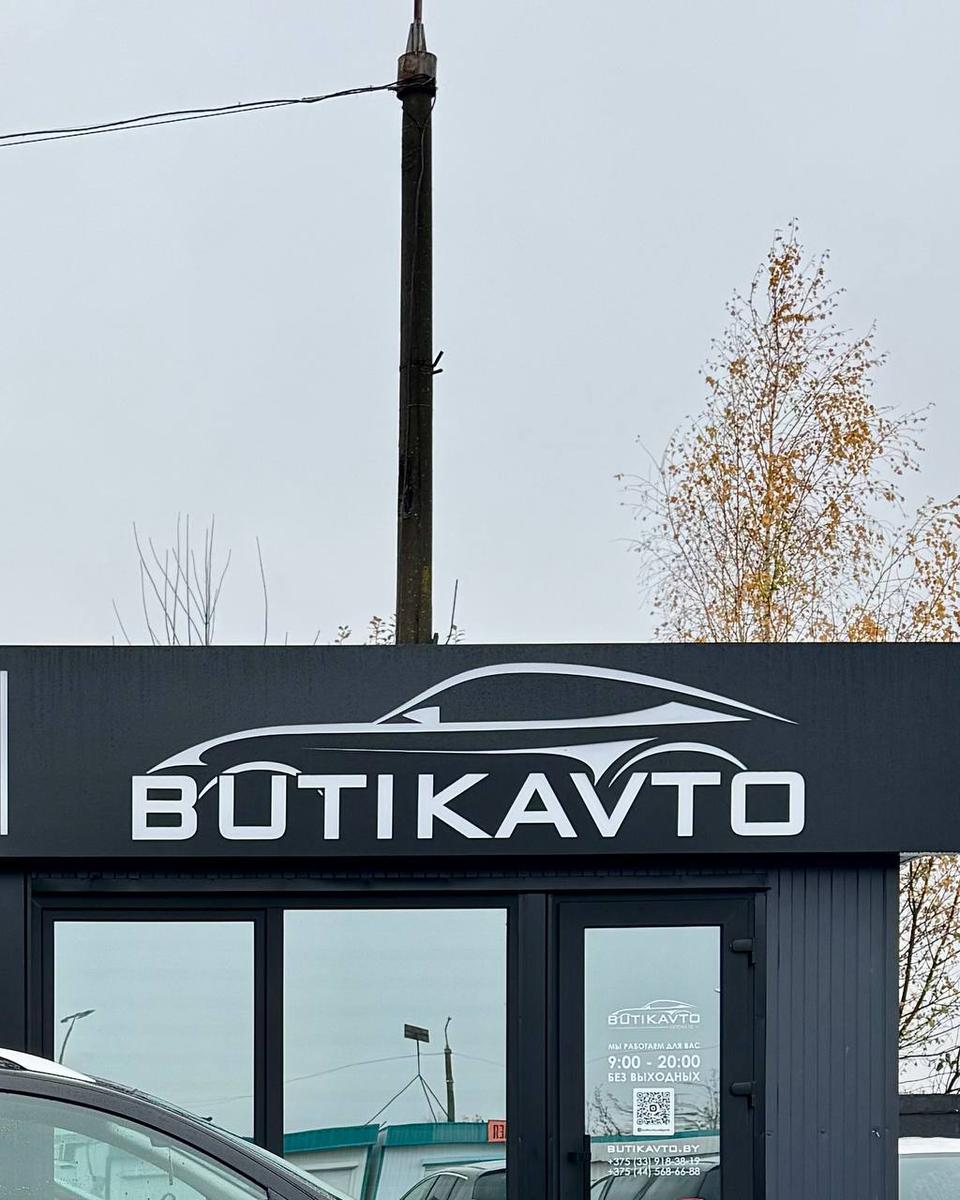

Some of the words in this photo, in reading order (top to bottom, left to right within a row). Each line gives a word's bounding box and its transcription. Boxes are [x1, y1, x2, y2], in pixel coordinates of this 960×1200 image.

[132, 771, 805, 841] BUTIKAVTO
[608, 1014, 700, 1025] BUTIKAVTO
[608, 1042, 621, 1050] МЫ
[608, 1055, 641, 1069] 9:00
[657, 1055, 700, 1069] 20:00
[608, 1072, 627, 1082] БЕЗ
[631, 1072, 700, 1083] ВЫХОДНЫХ
[607, 1144, 700, 1153] BUTIKAVTO.BY
[608, 1157, 631, 1166] +375
[633, 1157, 651, 1167] (33)
[608, 1167, 631, 1176] +375
[633, 1167, 651, 1178] (44)
[654, 1167, 700, 1176] 568-66-88
